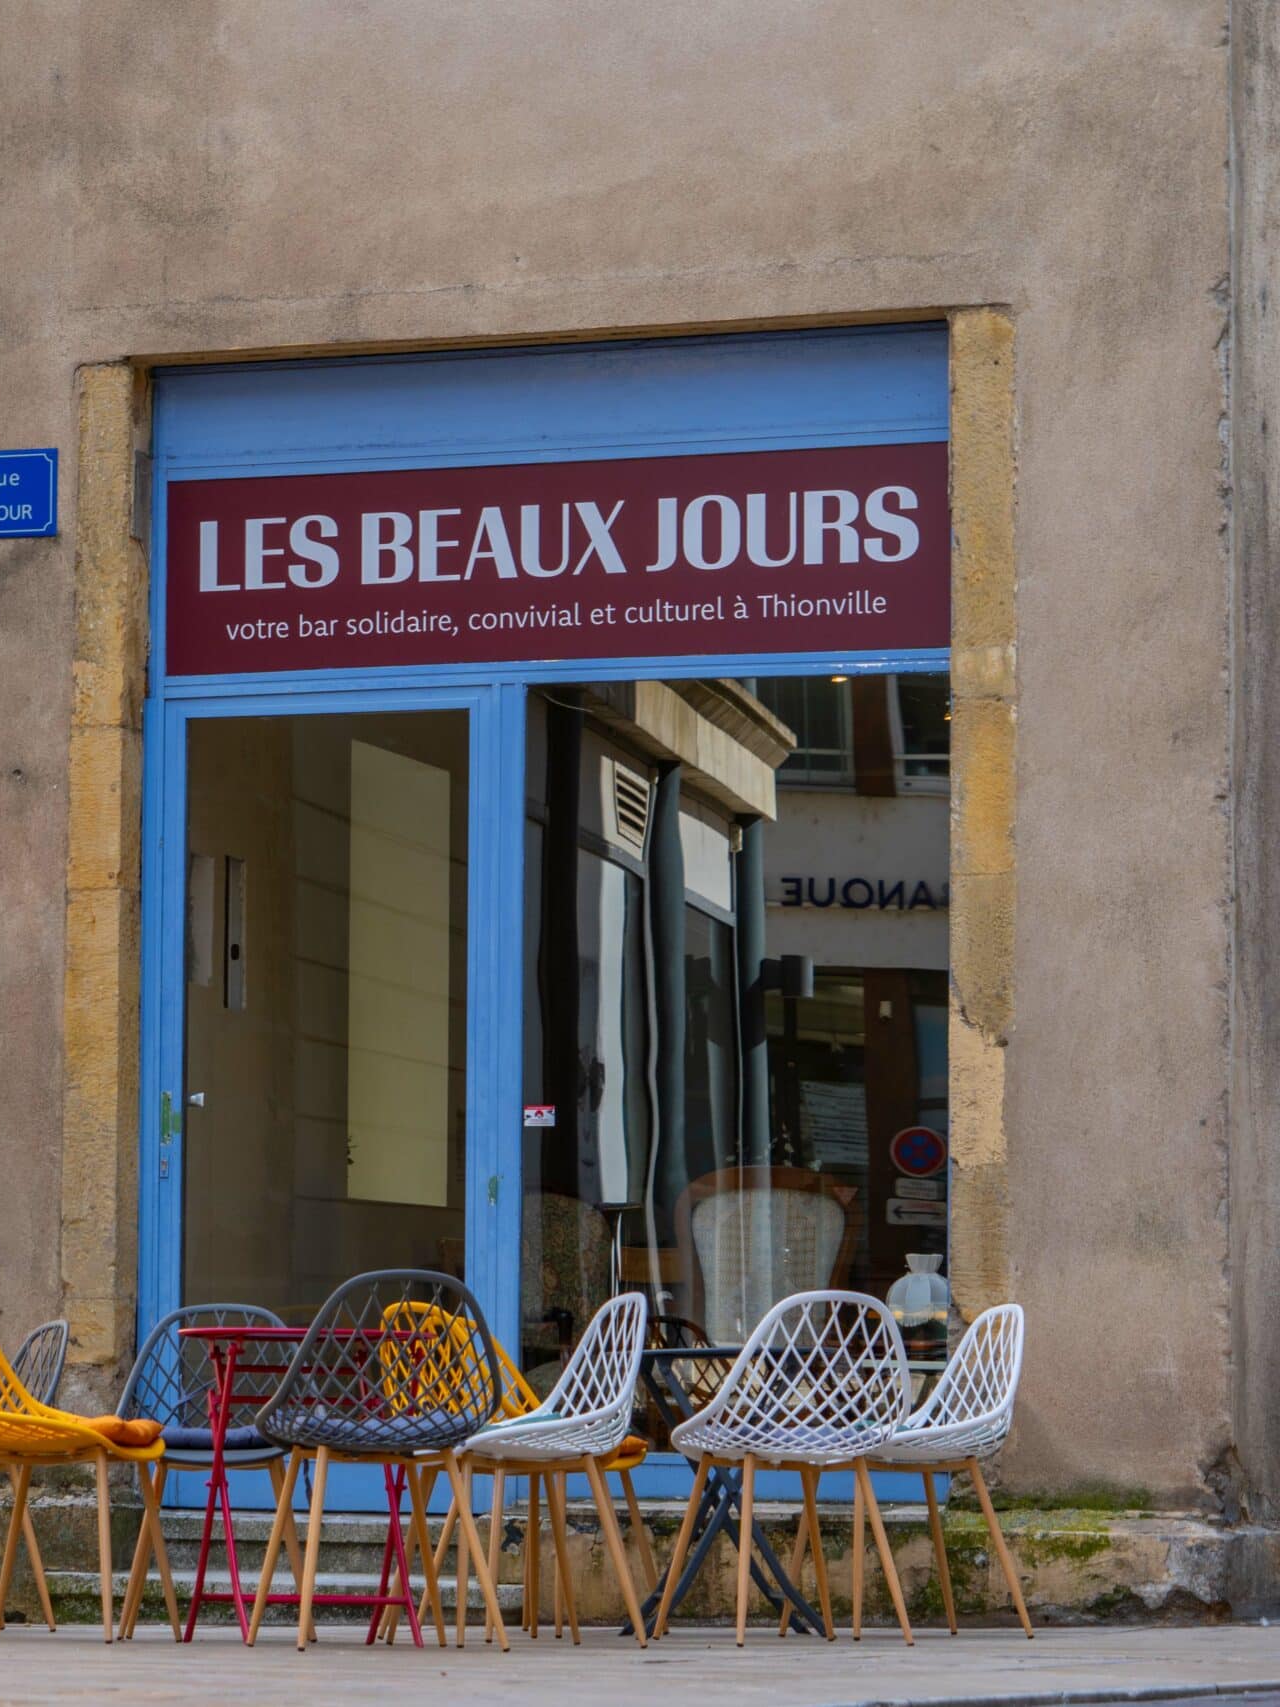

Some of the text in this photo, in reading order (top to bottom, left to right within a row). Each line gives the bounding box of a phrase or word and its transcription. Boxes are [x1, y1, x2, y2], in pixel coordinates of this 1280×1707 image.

[198, 485, 921, 593] LES BEAUX JOURS
[226, 589, 887, 641] votre bar solidaire, convivial et culturel à Thionville
